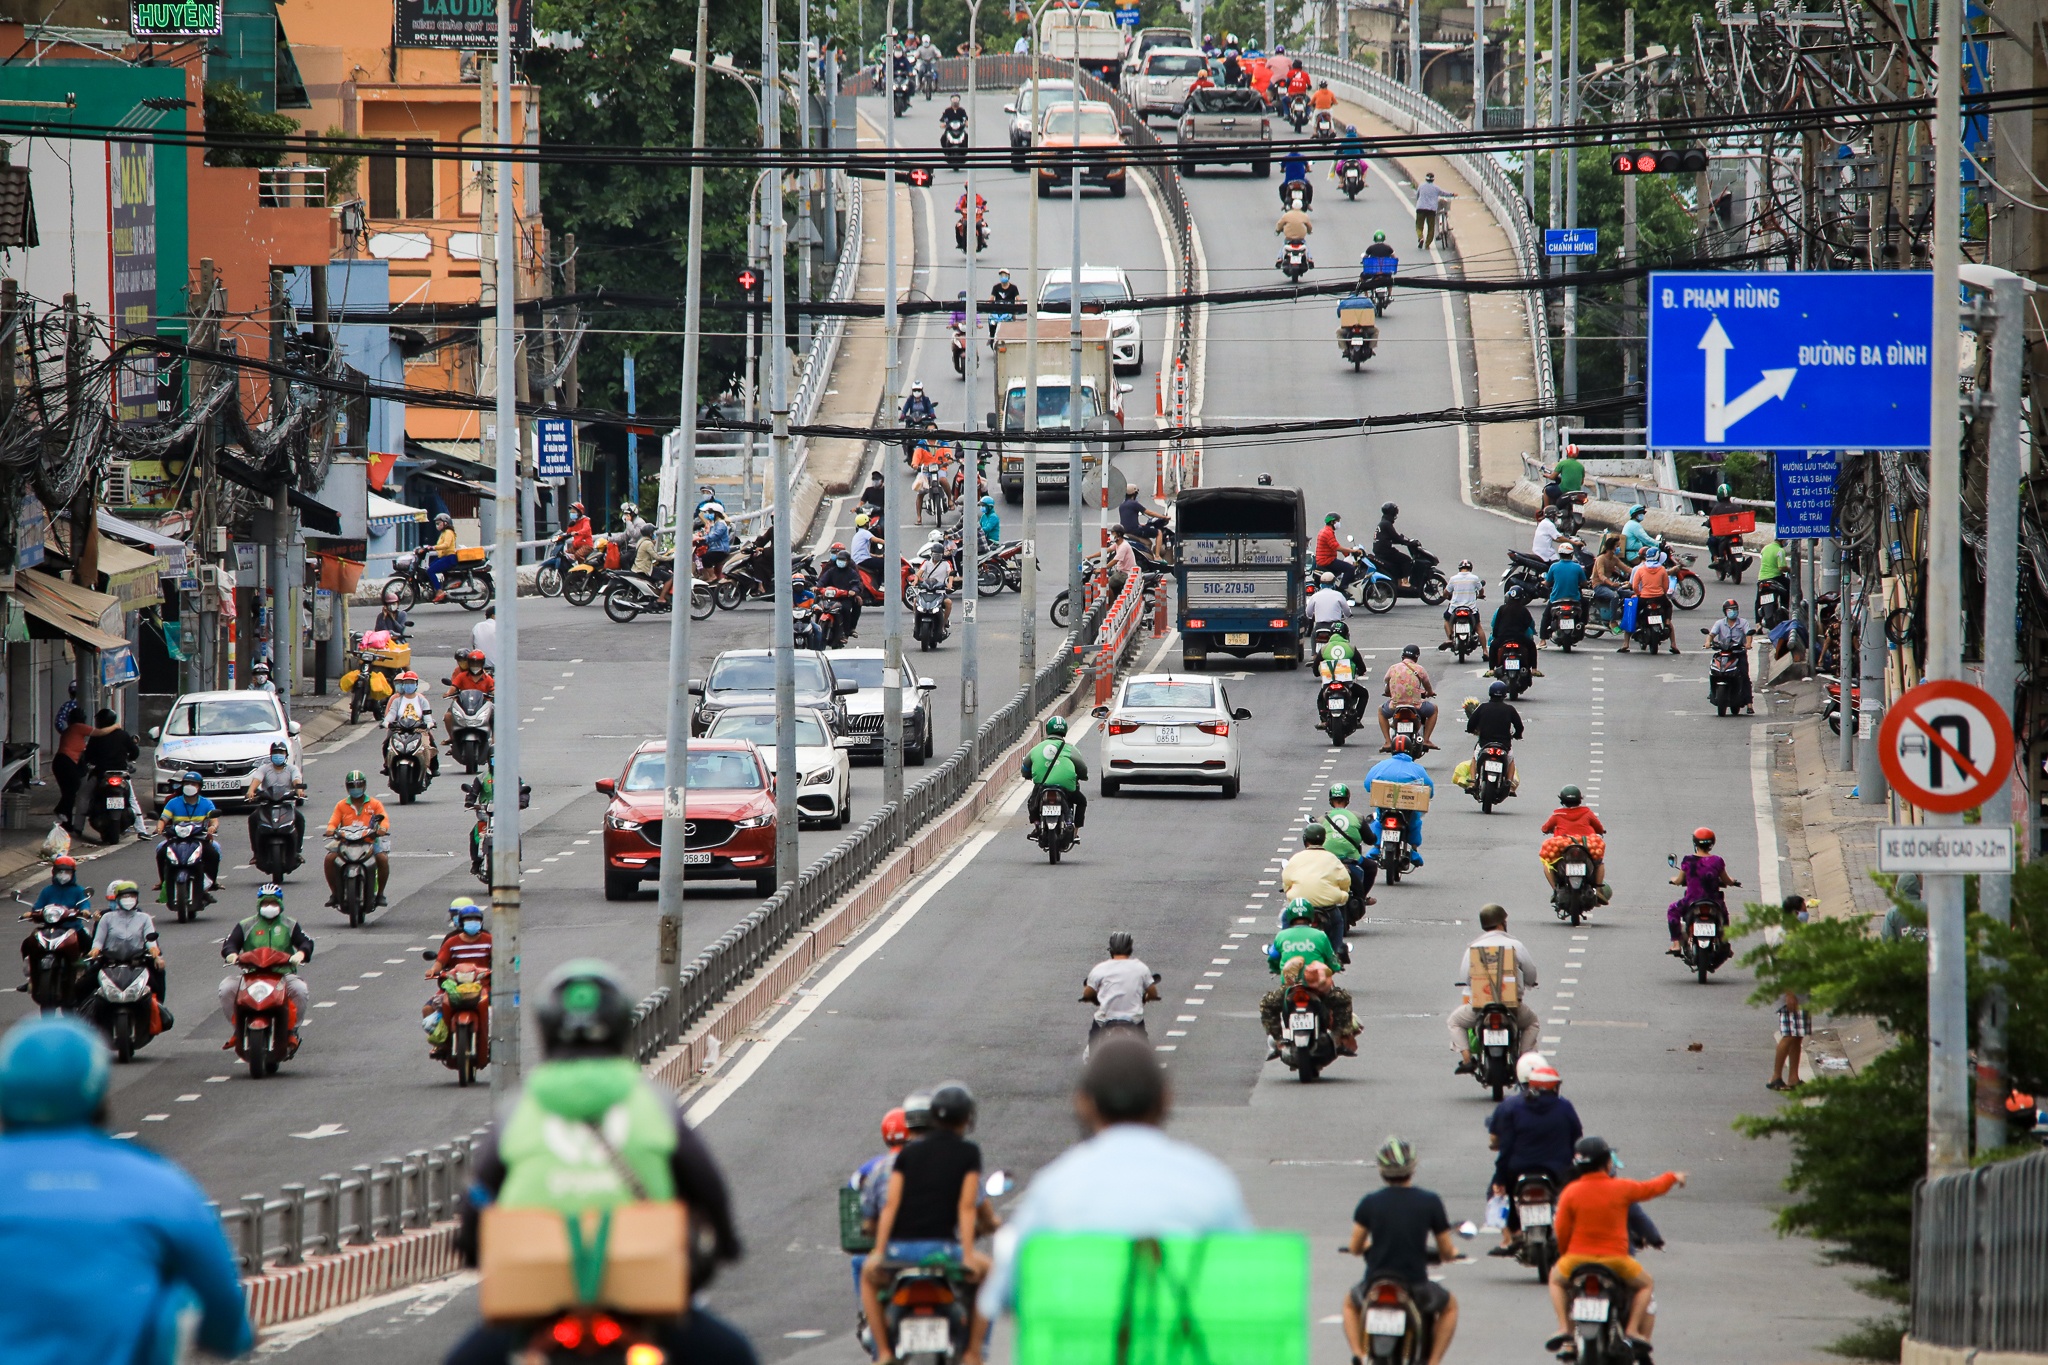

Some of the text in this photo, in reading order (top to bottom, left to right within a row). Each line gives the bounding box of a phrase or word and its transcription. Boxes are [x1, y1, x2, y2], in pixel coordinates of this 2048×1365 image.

[1661, 283, 1780, 311] Đ. PHẠM HÙNG
[1798, 340, 1927, 366] ĐƯỜNG BA ĐÌNH
[1818, 461, 1837, 470] THÔNG
[1788, 476, 1796, 484] XE
[1792, 488, 1800, 496] XE
[1283, 939, 1316, 953] Grab
